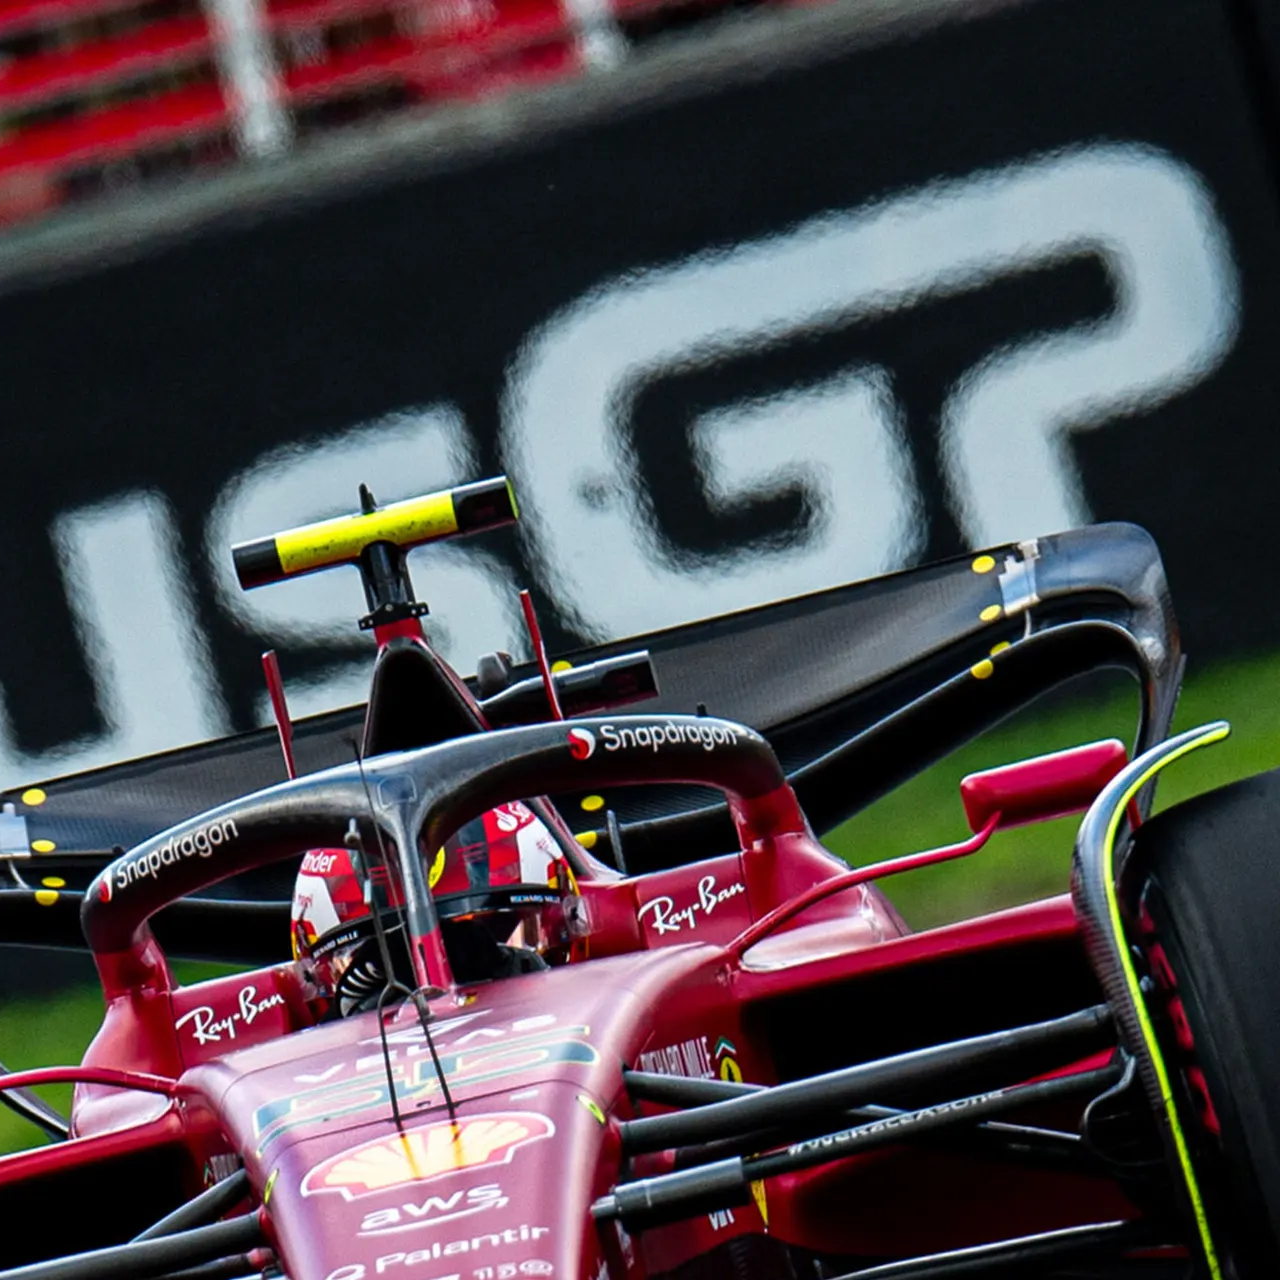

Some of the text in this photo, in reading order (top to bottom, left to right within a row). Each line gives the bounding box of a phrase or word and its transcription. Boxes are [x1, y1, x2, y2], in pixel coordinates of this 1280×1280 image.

[600, 720, 737, 752] Snapdragon
[116, 817, 239, 889] Snapdragon
[638, 876, 745, 935] Ray-Ban
[175, 986, 285, 1045] Ray-Ban
[361, 1183, 504, 1230] aws
[376, 1224, 550, 1273] Palantir
